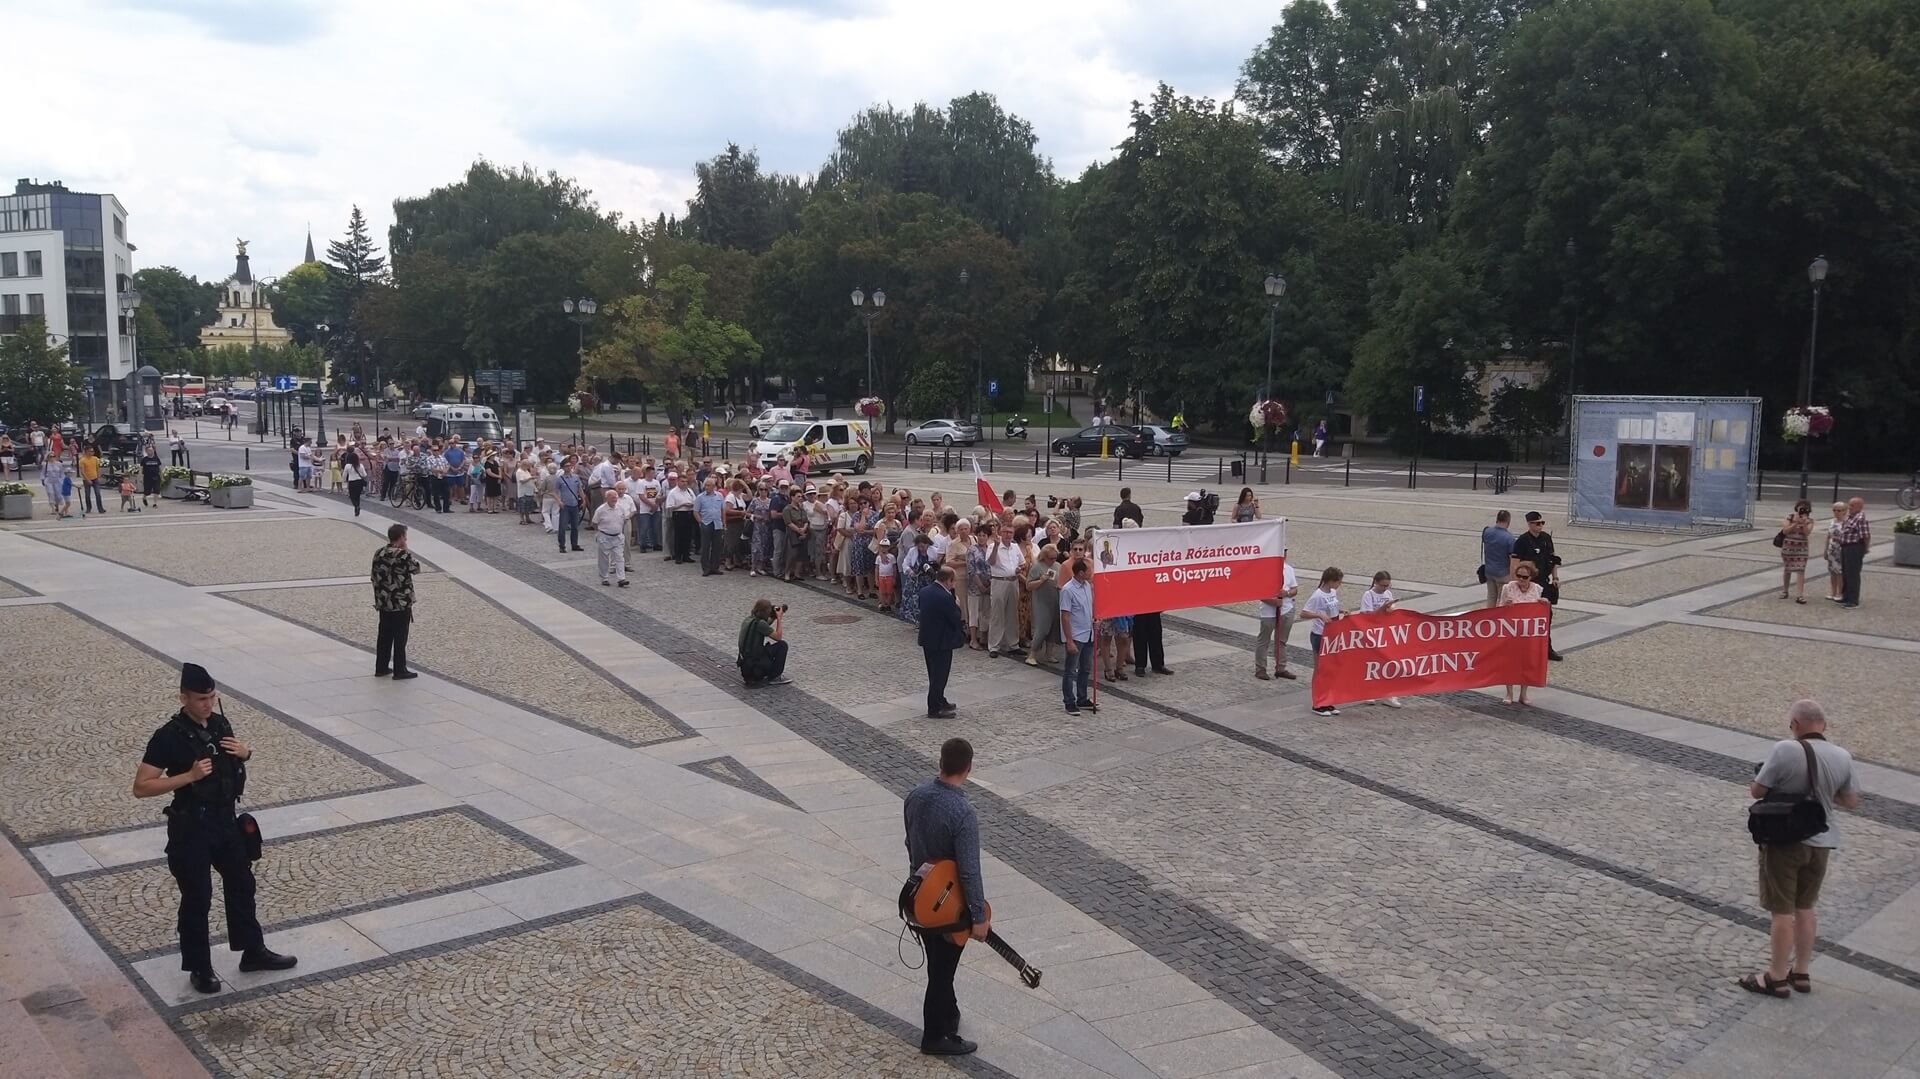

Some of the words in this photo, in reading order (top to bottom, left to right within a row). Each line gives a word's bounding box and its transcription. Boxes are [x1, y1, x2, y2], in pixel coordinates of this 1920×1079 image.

[990, 382, 997, 393] P
[1127, 551, 1182, 565] Krucjata
[1185, 545, 1261, 560] Różańcowa
[1155, 572, 1169, 583] za
[1172, 566, 1231, 583] Ojczyznę
[1319, 627, 1388, 656] MARSZ
[1389, 623, 1411, 645] W
[1416, 617, 1548, 642] OBRONIE
[1364, 651, 1480, 681] RODZINY
